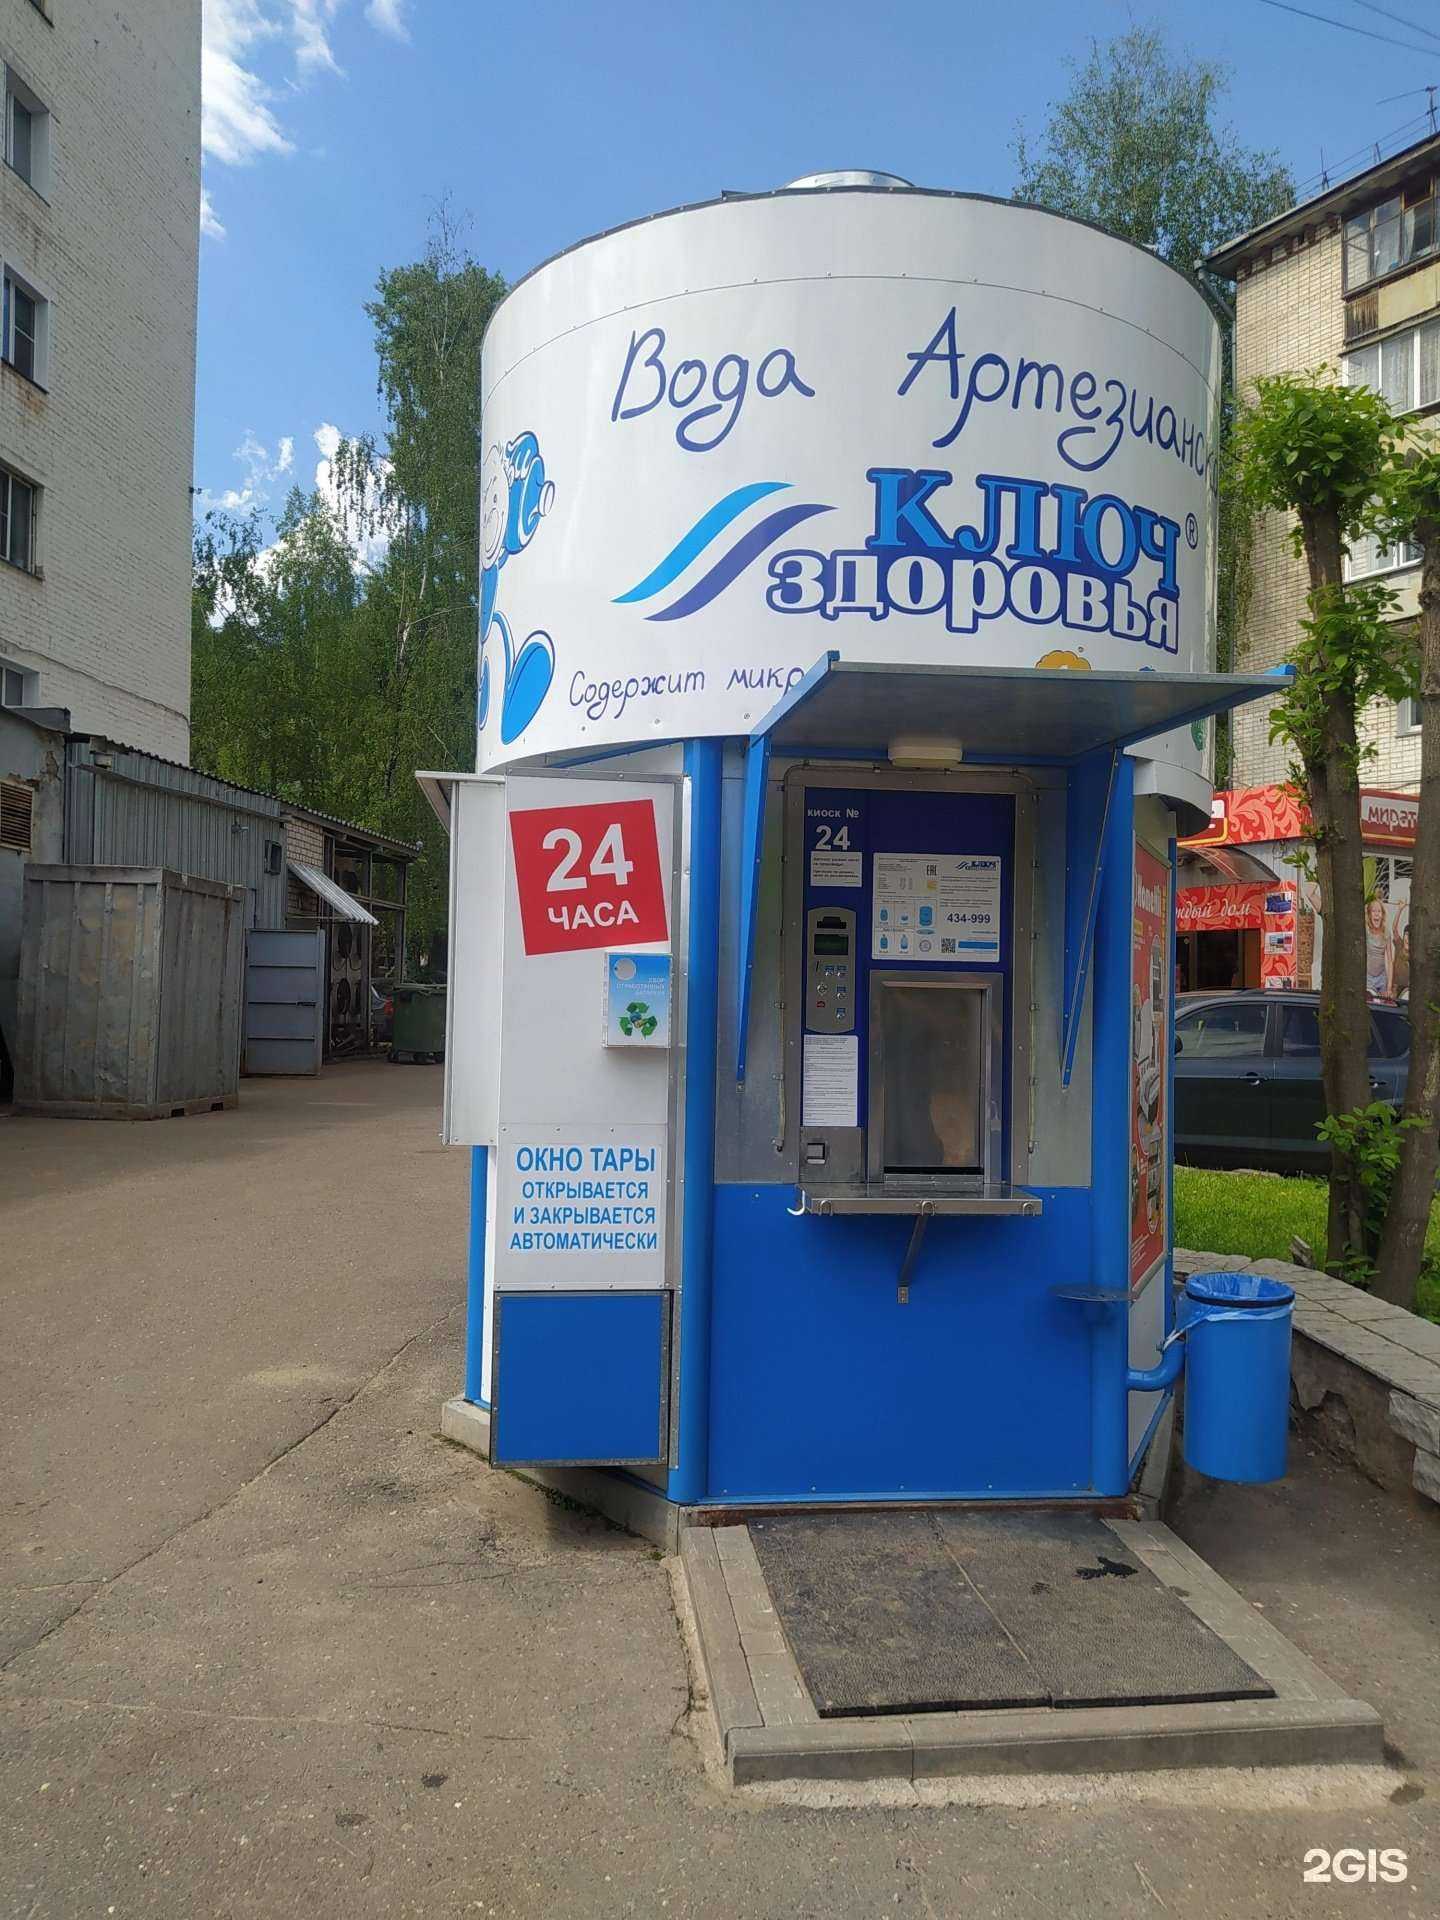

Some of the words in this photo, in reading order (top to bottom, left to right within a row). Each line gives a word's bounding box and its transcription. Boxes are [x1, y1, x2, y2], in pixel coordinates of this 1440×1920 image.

[611, 327, 816, 453] Вода
[866, 468, 1181, 594] КЛЮЧ
[569, 670, 705, 721] Содержит
[815, 825, 851, 851] 24
[542, 823, 634, 892] 24
[547, 900, 640, 930] ЧАСА
[947, 912, 991, 924] 434-999
[516, 1146, 583, 1172] ОКНО
[591, 1147, 656, 1172] ТАРЫ
[522, 1181, 649, 1199] ОТКРЫВАЕТСЯ
[514, 1207, 525, 1224] И
[530, 1206, 656, 1225] ЗАКРЫВАЕТСЯ
[510, 1232, 657, 1250] АВТОМАТИЧЕСКИ
